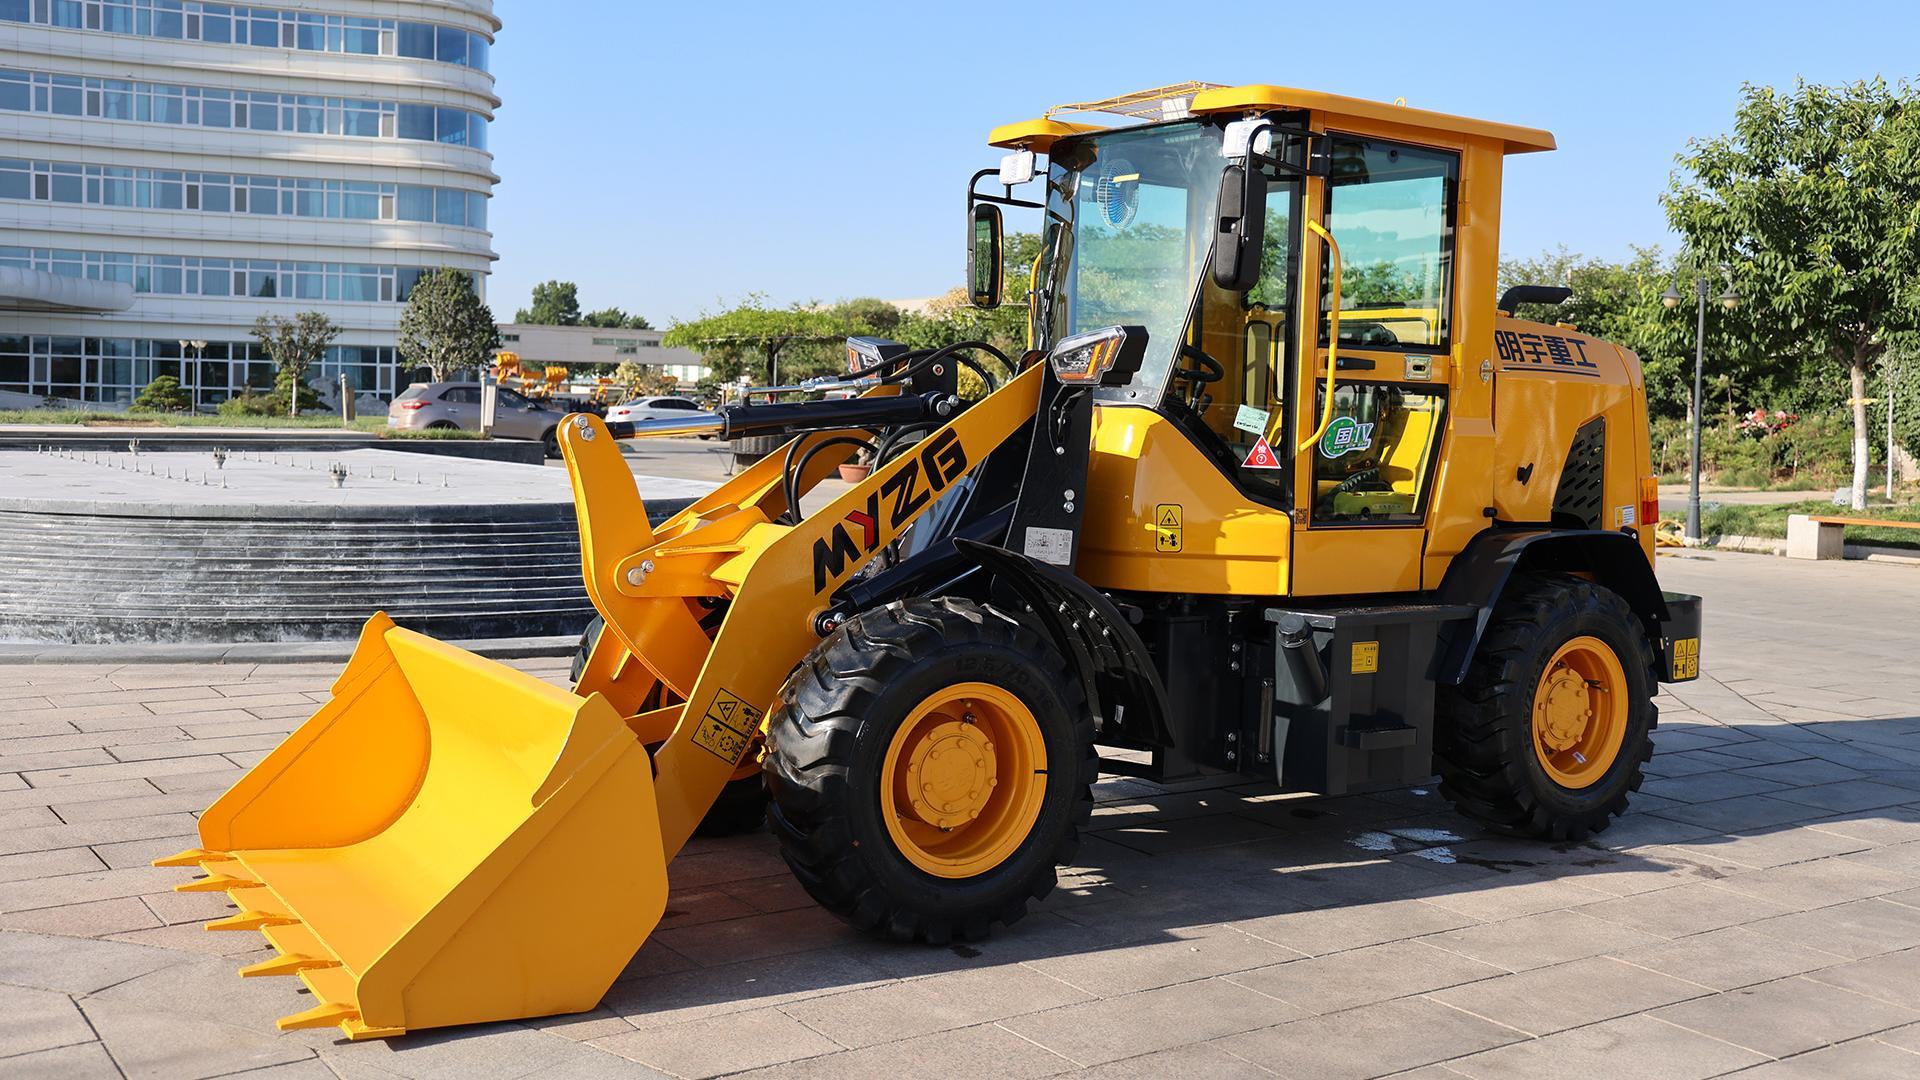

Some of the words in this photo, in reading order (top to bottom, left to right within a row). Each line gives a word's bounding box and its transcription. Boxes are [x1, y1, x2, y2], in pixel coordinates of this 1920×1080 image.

[1495, 330, 1597, 368] 明宇重工
[813, 427, 968, 596] MYZG
